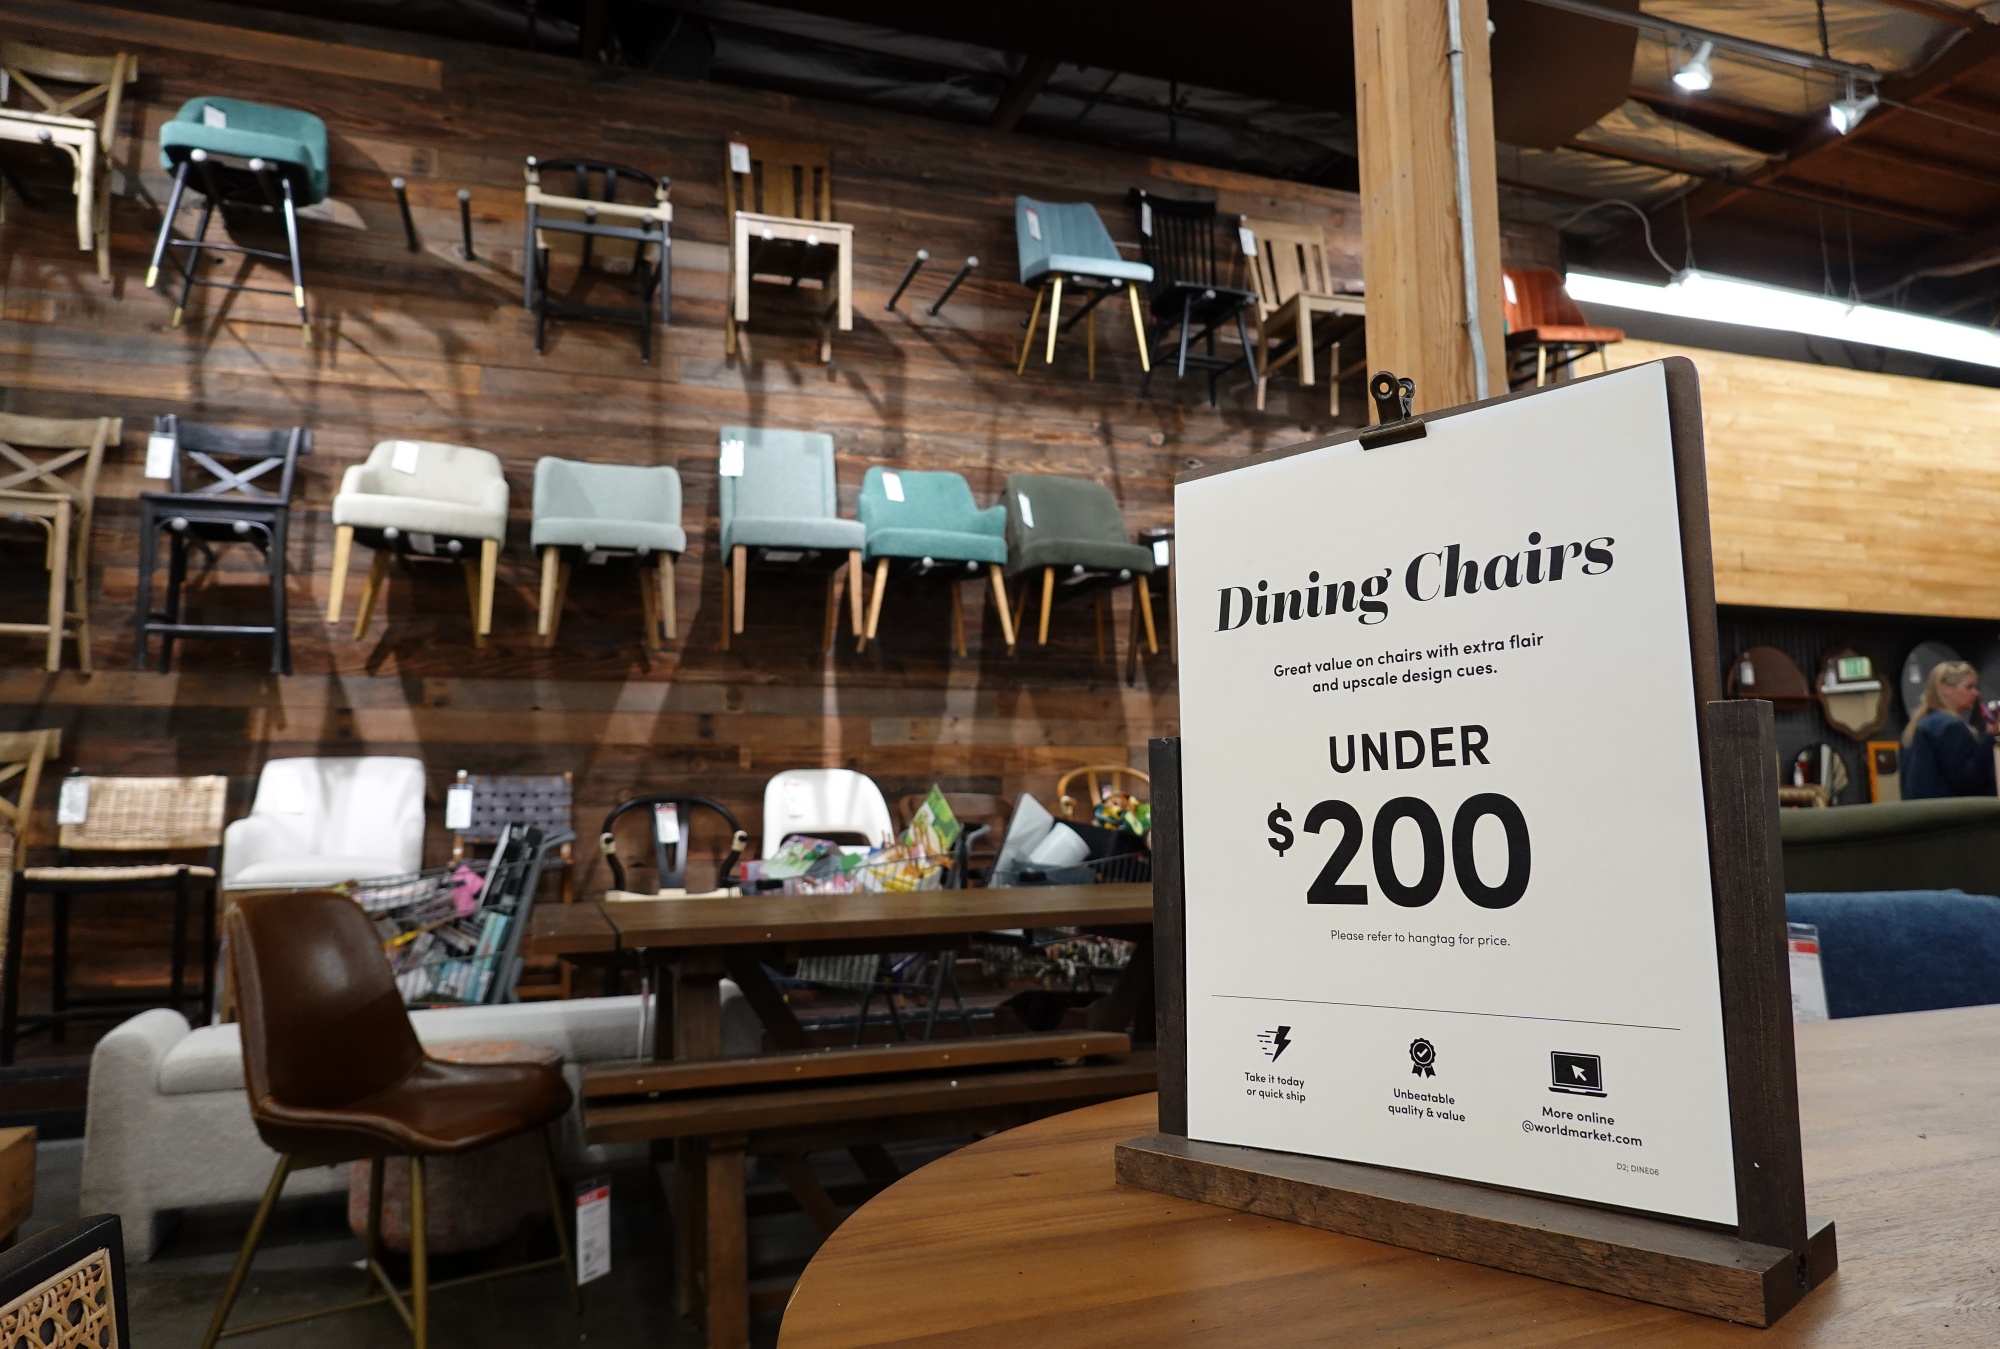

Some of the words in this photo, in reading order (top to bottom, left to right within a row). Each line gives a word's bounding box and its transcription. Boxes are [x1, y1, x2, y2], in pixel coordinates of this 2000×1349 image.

[1215, 568, 1392, 632] Dining
[1405, 531, 1615, 602] Chairs
[1274, 662, 1311, 677] Great
[1315, 658, 1352, 673] value
[1356, 657, 1374, 667] on
[1378, 649, 1422, 665] chairs
[1426, 643, 1458, 659] with
[1463, 640, 1504, 655] extra
[1509, 633, 1543, 649] flair
[1312, 678, 1338, 692] and
[1343, 671, 1397, 692] upscale
[1402, 667, 1452, 684] design
[1457, 665, 1497, 679] cues.
[1329, 724, 1490, 773] UNDER
[1267, 793, 1531, 909] $200
[1331, 930, 1365, 941] Please
[1368, 931, 1393, 942] refer
[1395, 932, 1406, 942] to
[1409, 932, 1455, 947] hangtag
[1457, 934, 1474, 945] for
[1478, 937, 1511, 948] price.
[1245, 1071, 1265, 1083] Take
[1268, 1074, 1275, 1084] it
[1277, 1076, 1304, 1089] today
[1246, 1089, 1257, 1097] or
[1259, 1089, 1284, 1100] quick
[1286, 1091, 1306, 1104] ship
[1394, 1088, 1455, 1105] Unbeatable
[1388, 1104, 1423, 1119] quality
[1426, 1108, 1435, 1118] &
[1436, 1110, 1466, 1122] value
[1542, 1106, 1574, 1120] More
[1577, 1112, 1615, 1126] online
[1522, 1120, 1643, 1147] @worldmarket.com
[1616, 1163, 1629, 1172] D2;
[1631, 1165, 1659, 1176] DINE06
